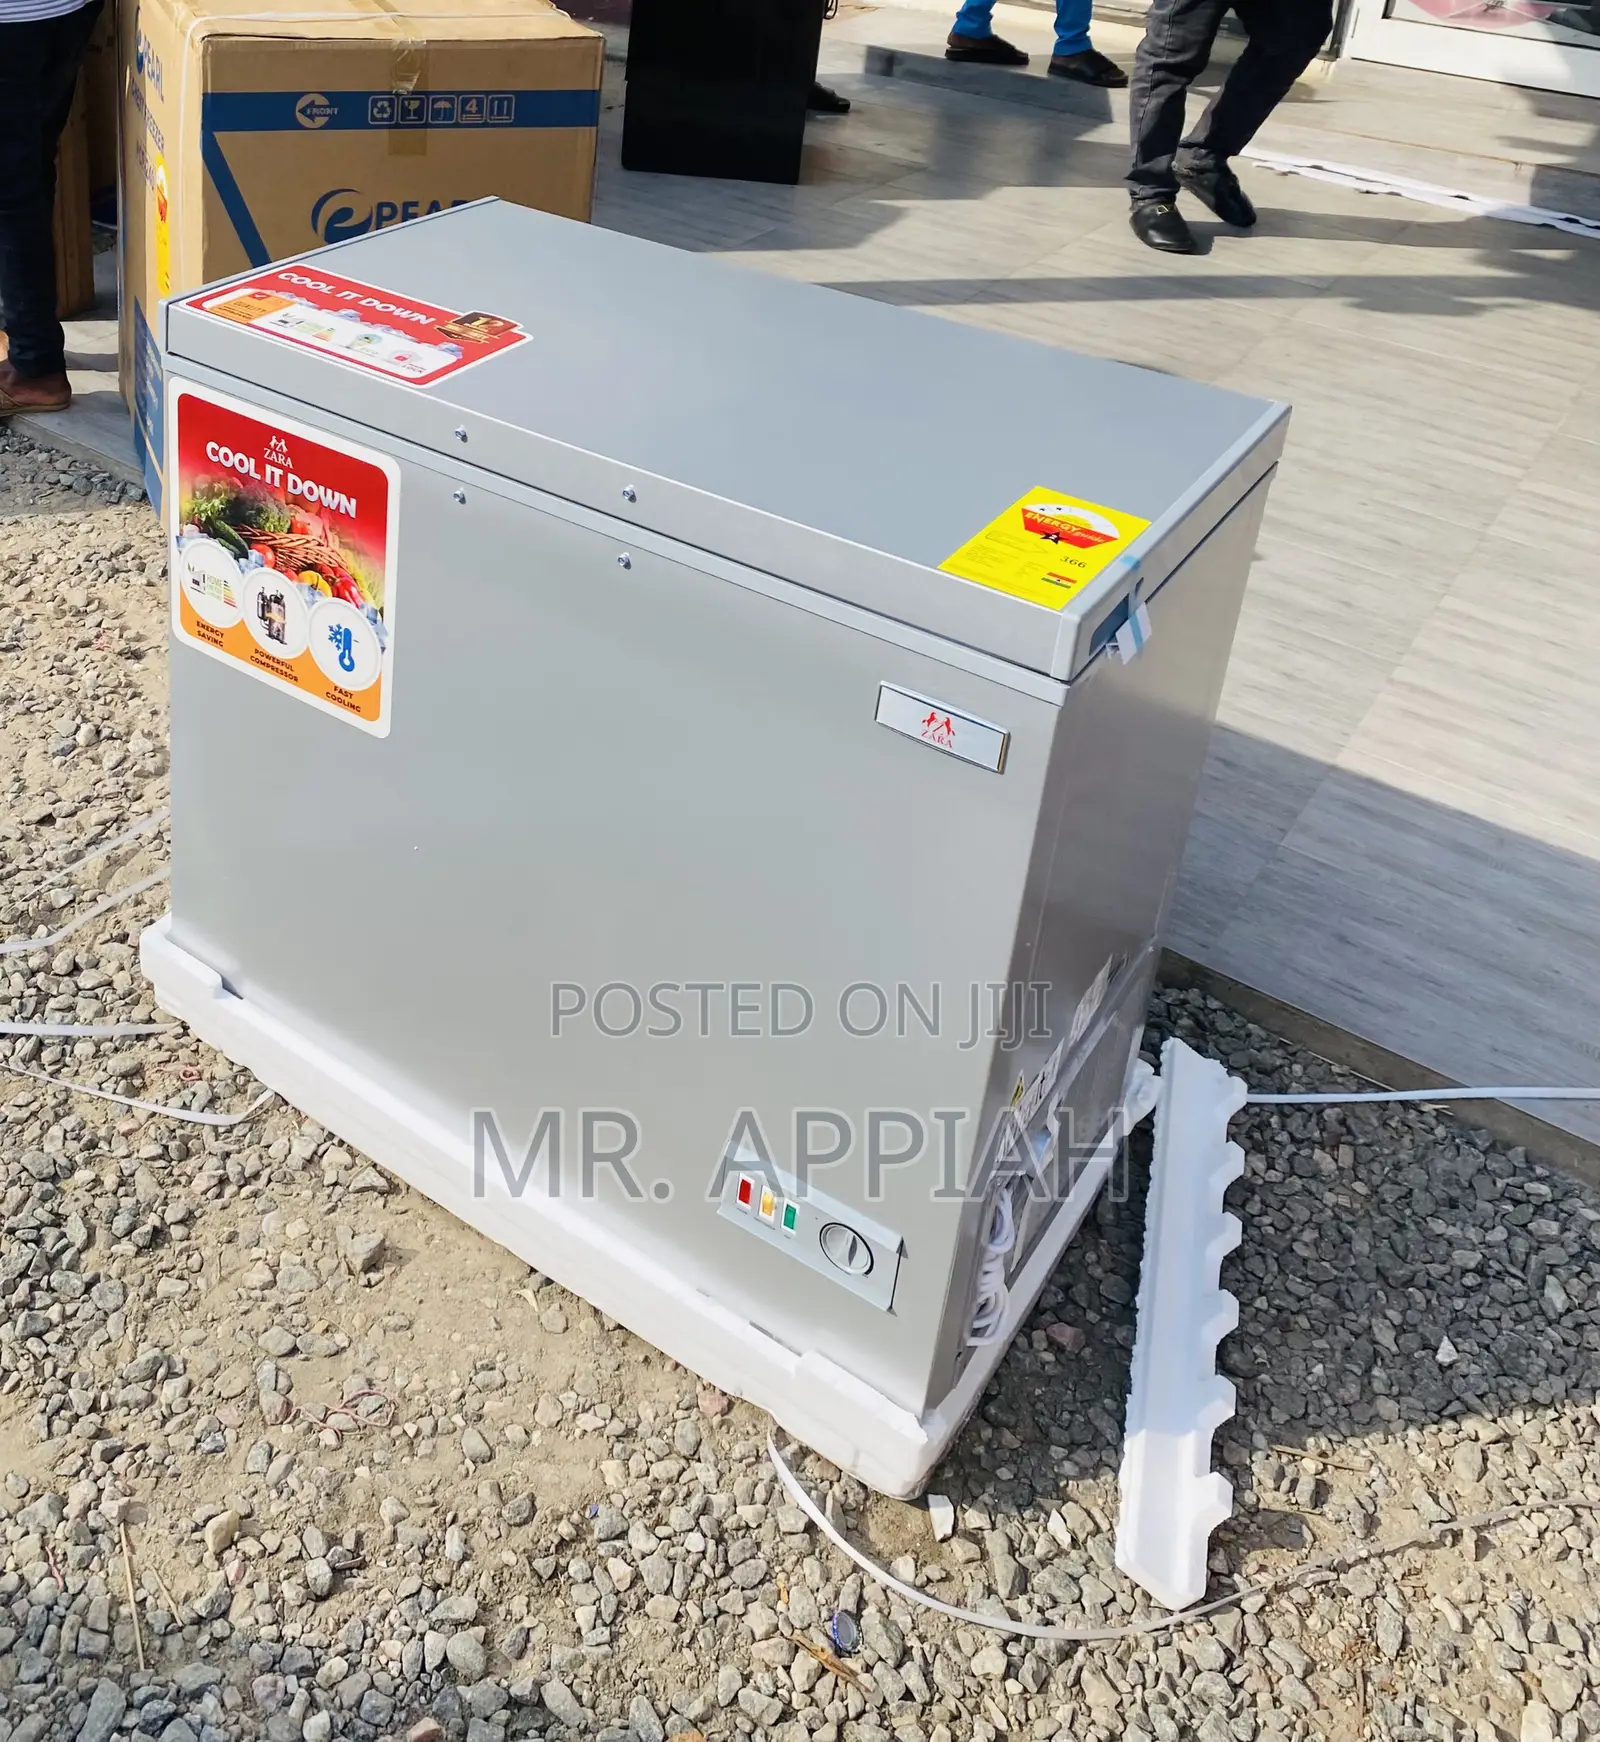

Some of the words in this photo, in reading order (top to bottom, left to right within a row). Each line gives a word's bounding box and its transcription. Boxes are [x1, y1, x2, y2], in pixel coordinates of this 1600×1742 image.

[277, 272, 337, 294] COOL
[336, 290, 363, 301] IT
[357, 297, 437, 325] DOWN
[263, 447, 294, 469] ZARA
[205, 440, 262, 481] COOL
[265, 463, 284, 488] IT
[287, 472, 357, 519] DOWN
[1024, 511, 1081, 533] ENERGY
[1059, 555, 1088, 569] 366
[196, 620, 225, 639] ENERGY
[196, 630, 225, 648] SAVING
[249, 655, 299, 683] COMPRESSOR
[254, 648, 294, 673] POWERFUL
[325, 691, 361, 713] COOLING
[333, 685, 354, 700] FAST
[921, 729, 953, 749] ZARA
